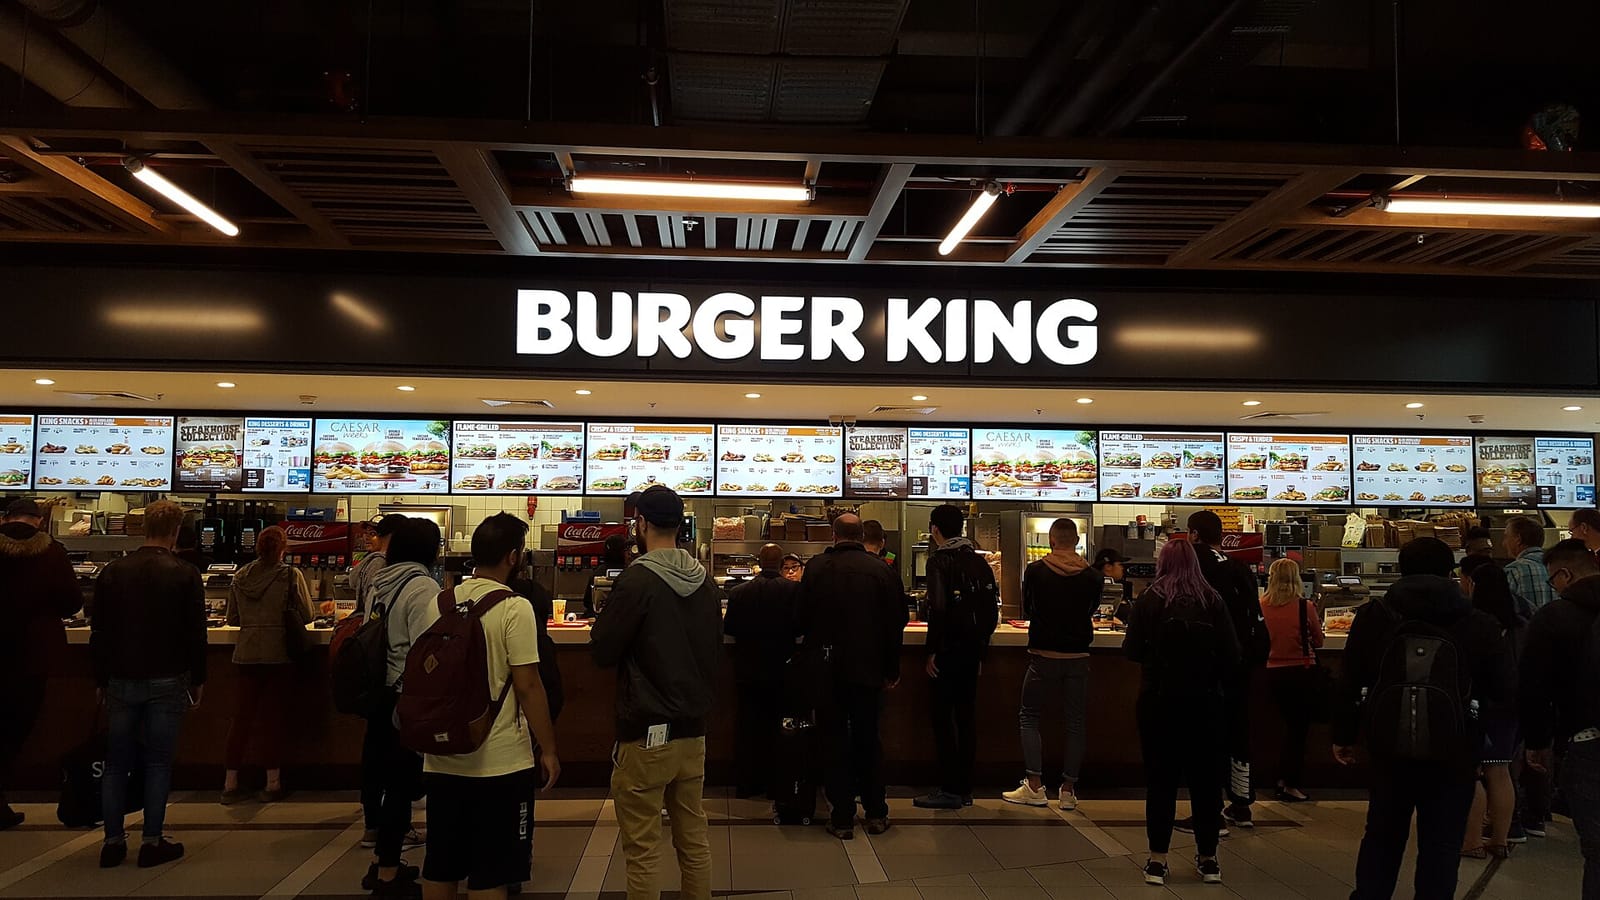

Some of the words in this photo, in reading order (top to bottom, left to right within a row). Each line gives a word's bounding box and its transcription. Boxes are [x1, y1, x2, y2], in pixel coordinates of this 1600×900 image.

[516, 288, 865, 363] BURGER
[886, 297, 1098, 365] KING
[41, 417, 58, 425] KING
[58, 417, 84, 425] SNACKS
[180, 424, 240, 434] STEAKHOUSE
[330, 422, 381, 432] CAESAR
[180, 432, 237, 442] COLLECTION
[848, 434, 904, 444] STEAKHOUSE
[986, 431, 1033, 442] CAESAR
[850, 442, 902, 451] COLLECTION
[1478, 444, 1532, 453] STEAKHOUSE
[1479, 451, 1529, 460] COLLECTION
[284, 524, 325, 538] Coca-Cola
[564, 525, 603, 539] Coca-Cola
